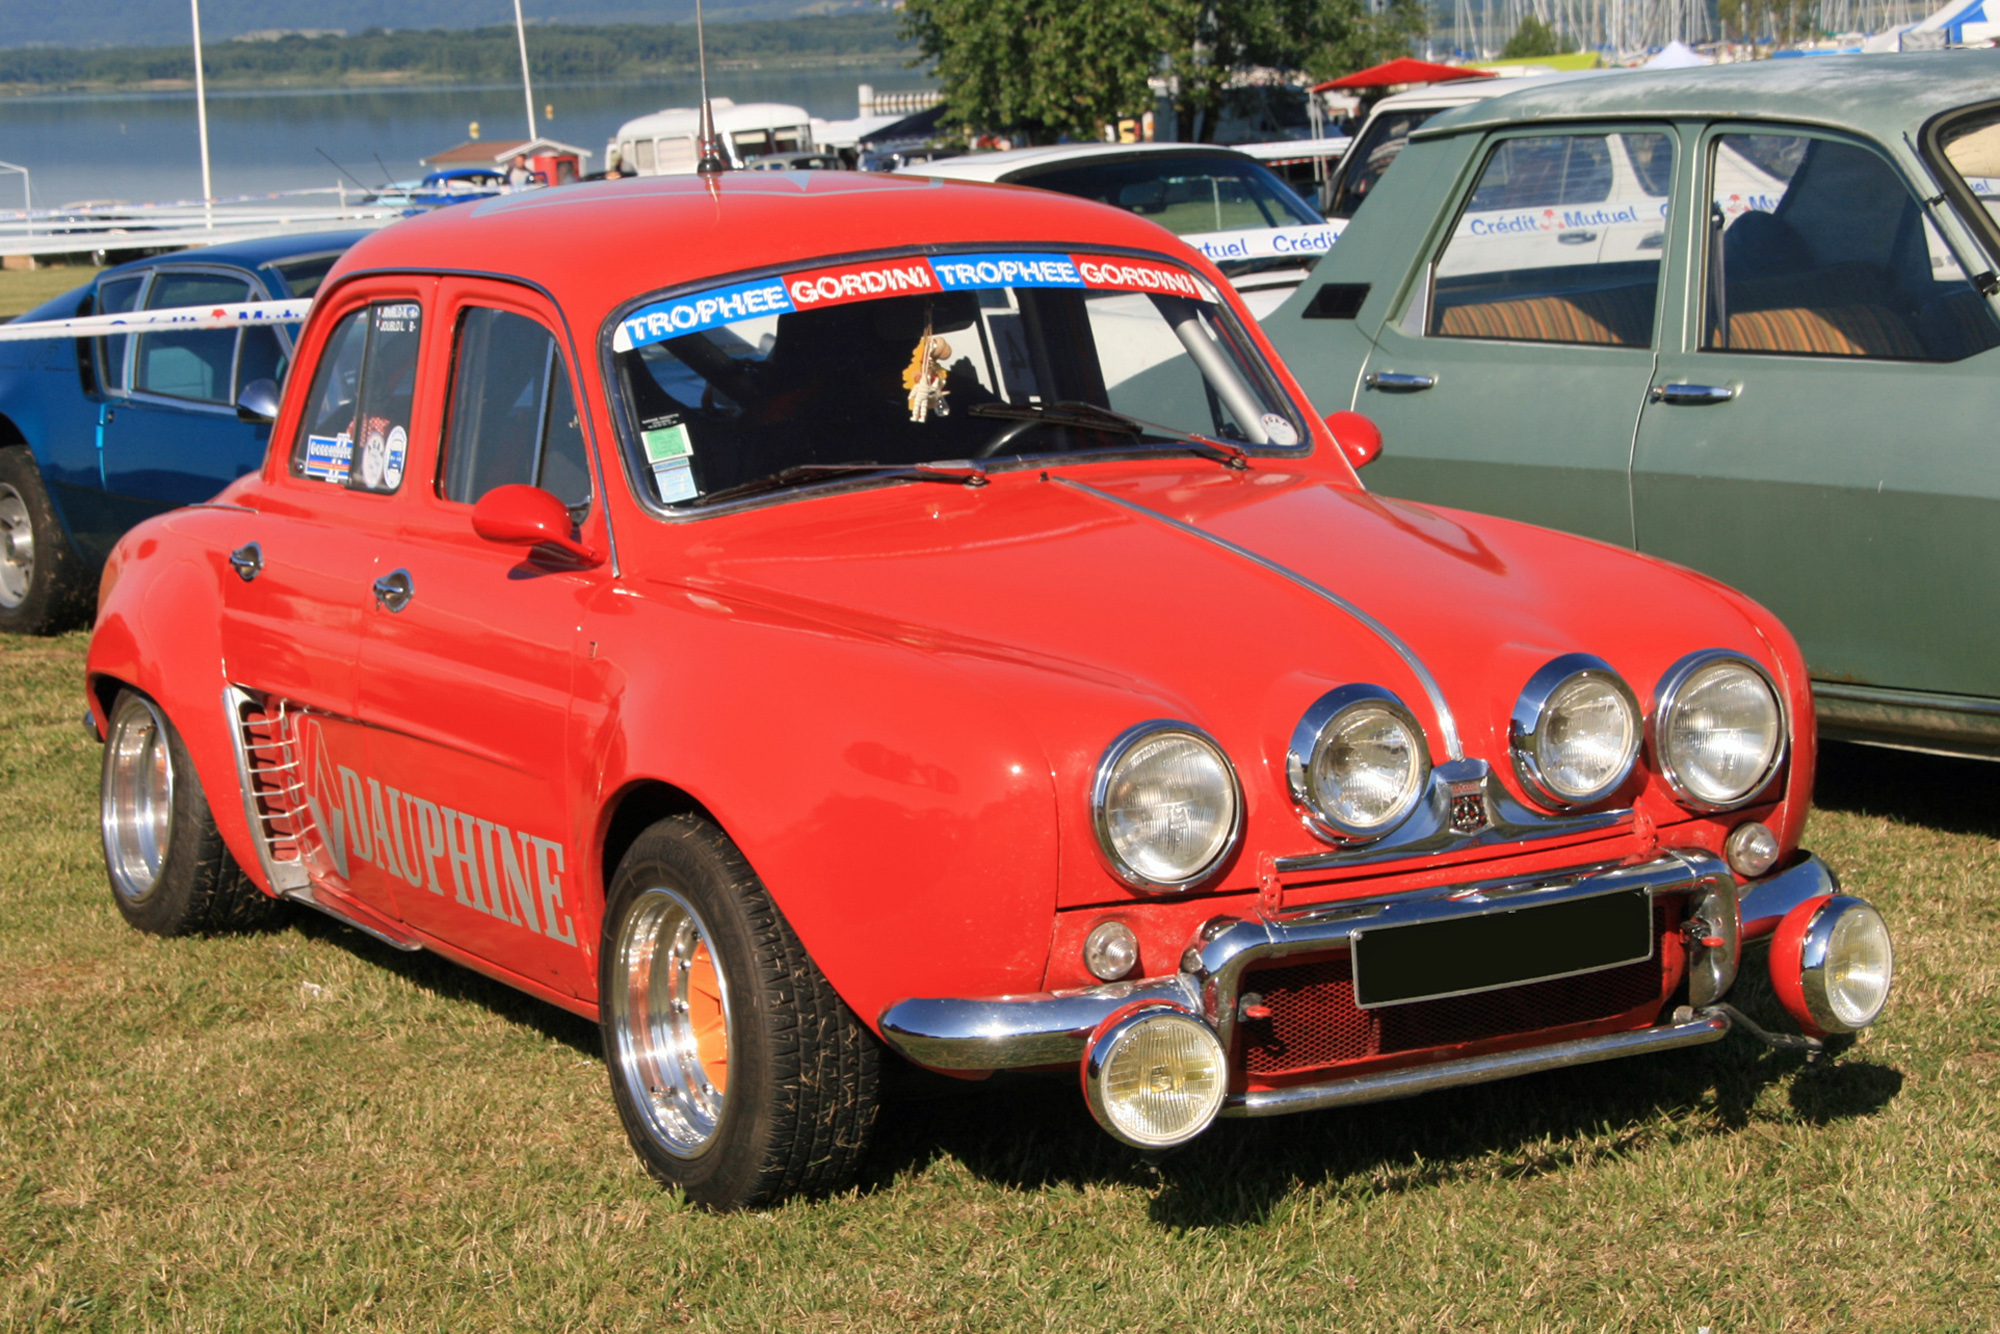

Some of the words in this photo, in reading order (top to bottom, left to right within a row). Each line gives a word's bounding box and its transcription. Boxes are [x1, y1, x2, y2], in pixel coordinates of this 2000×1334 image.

[1471, 215, 1539, 235] Crédit
[1564, 206, 1638, 228] Mutuel
[1198, 238, 1248, 258] tuel
[626, 286, 788, 340] TROPHEE
[791, 266, 931, 302] GORDINI
[936, 261, 1080, 285] TROPHEE
[1080, 262, 1195, 294] GORDINI
[338, 765, 577, 947] DAUPHINE
